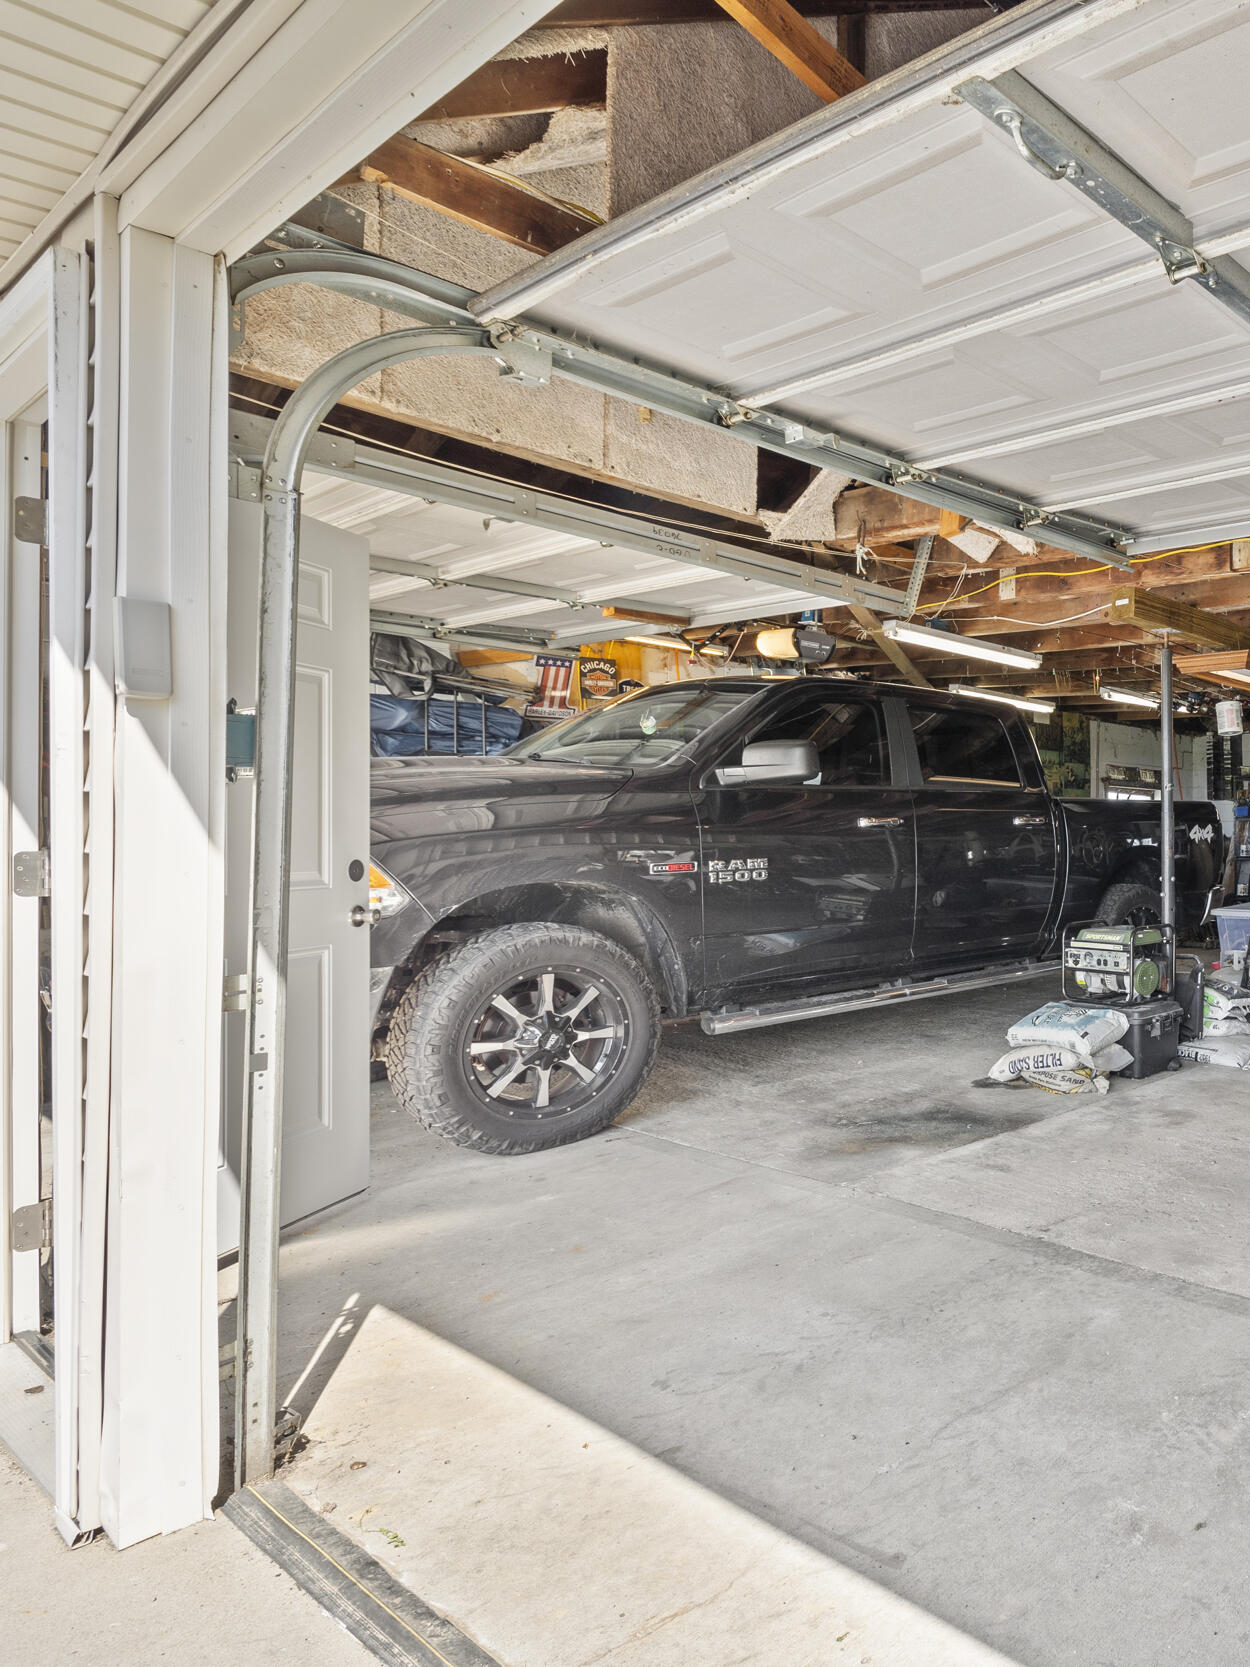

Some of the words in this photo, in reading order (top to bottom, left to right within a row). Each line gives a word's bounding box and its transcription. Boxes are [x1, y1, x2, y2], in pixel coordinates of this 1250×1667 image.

[580, 660, 616, 675] CHICAGO
[708, 858, 768, 872] RAM
[708, 869, 768, 884] 1500
[1084, 933, 1121, 941] SPORTSMAN
[1008, 1056, 1031, 1075] SAND
[1033, 1052, 1063, 1071] FILTER
[1061, 1075, 1085, 1085] SAND
